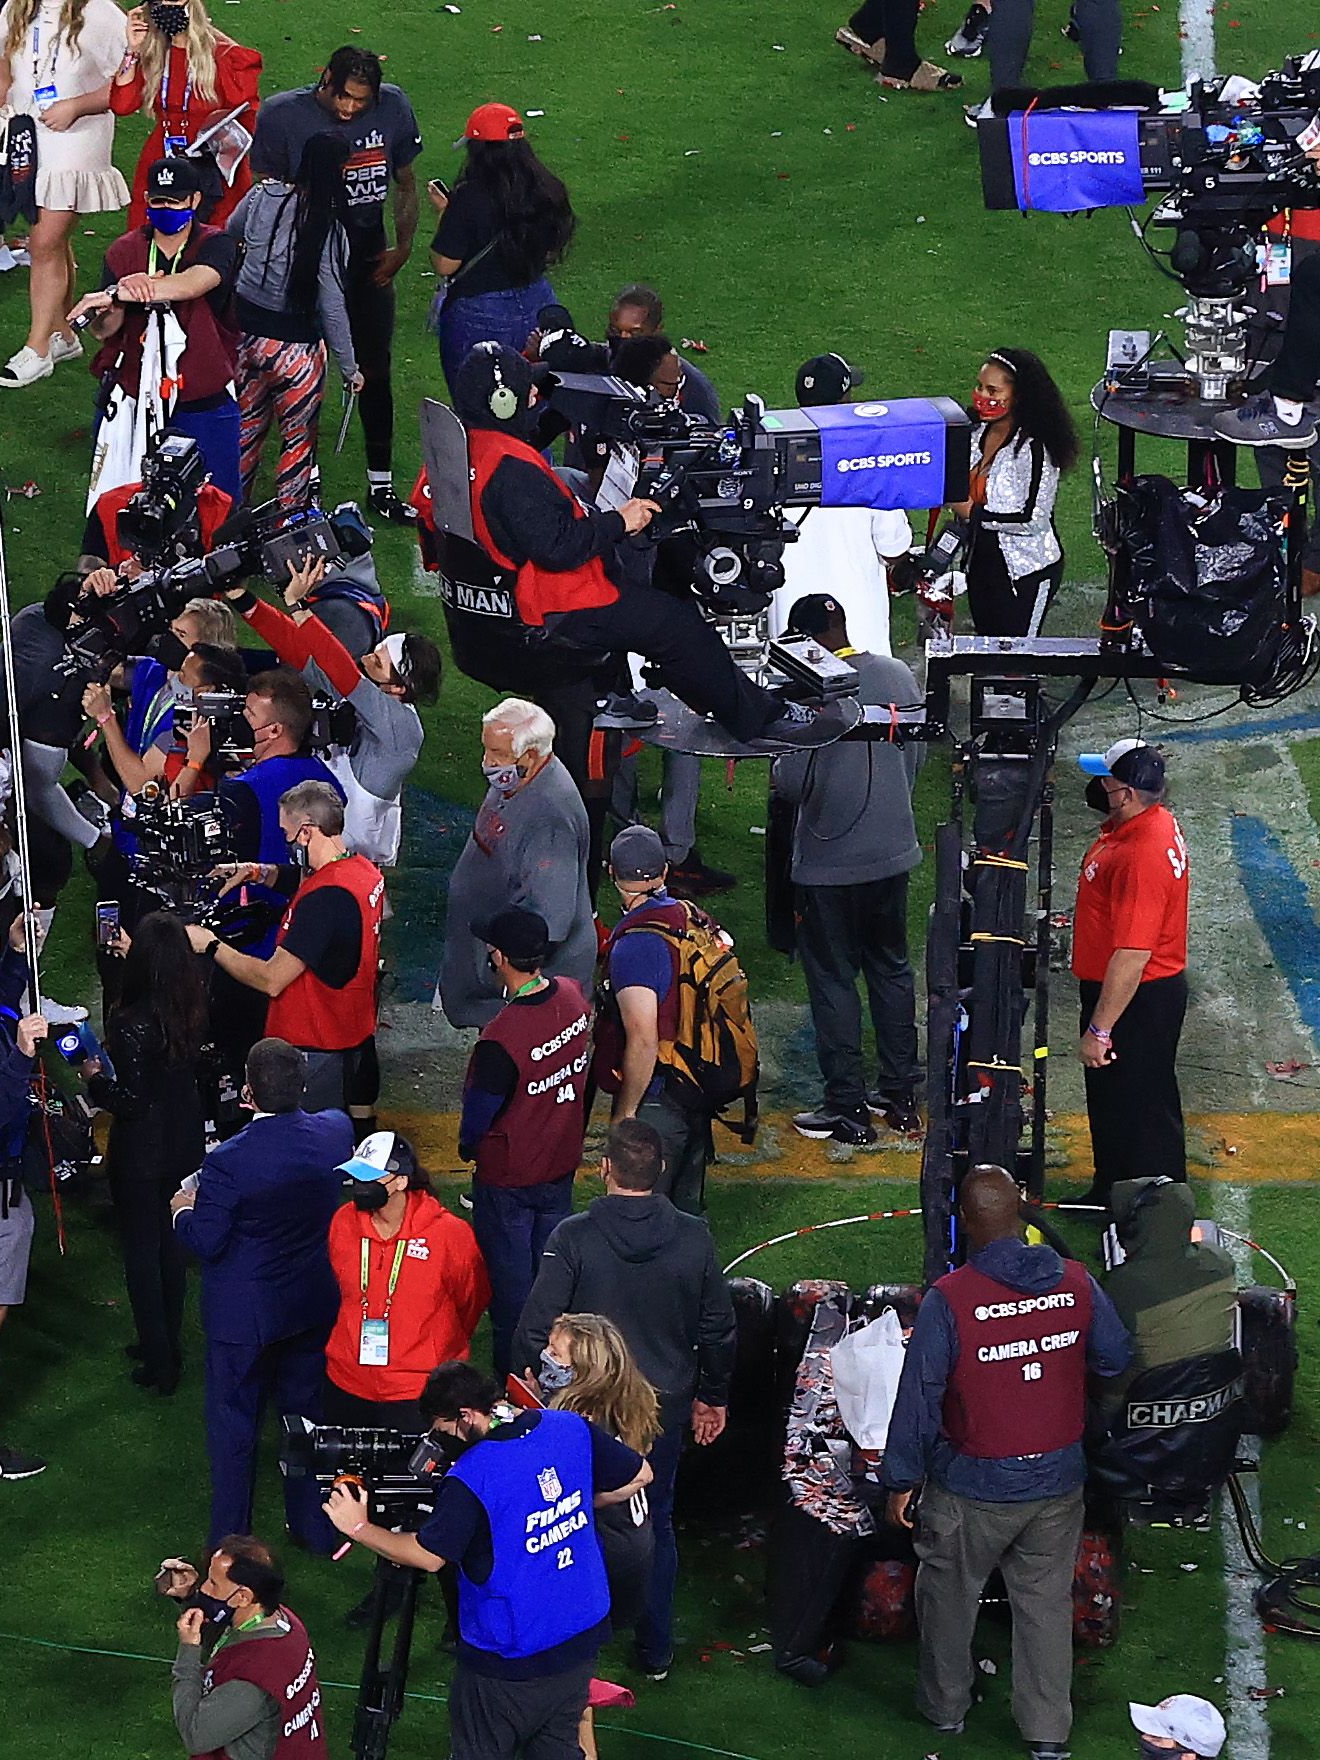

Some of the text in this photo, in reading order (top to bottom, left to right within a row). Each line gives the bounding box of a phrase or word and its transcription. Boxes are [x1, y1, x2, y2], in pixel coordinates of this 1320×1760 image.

[1040, 150, 1125, 165] CBS SPORTS
[1204, 176, 1216, 189] 5
[849, 451, 931, 471] CBS SPORTS
[743, 498, 754, 510] 9
[542, 1035, 562, 1056] CBS
[989, 1292, 1075, 1318] CBS SPORTS
[978, 1330, 1080, 1362] CAMERA CREW
[1021, 1362, 1042, 1381] 16
[526, 1490, 581, 1533] FILMS
[525, 1511, 589, 1554] CAMERA
[557, 1547, 574, 1570] 22
